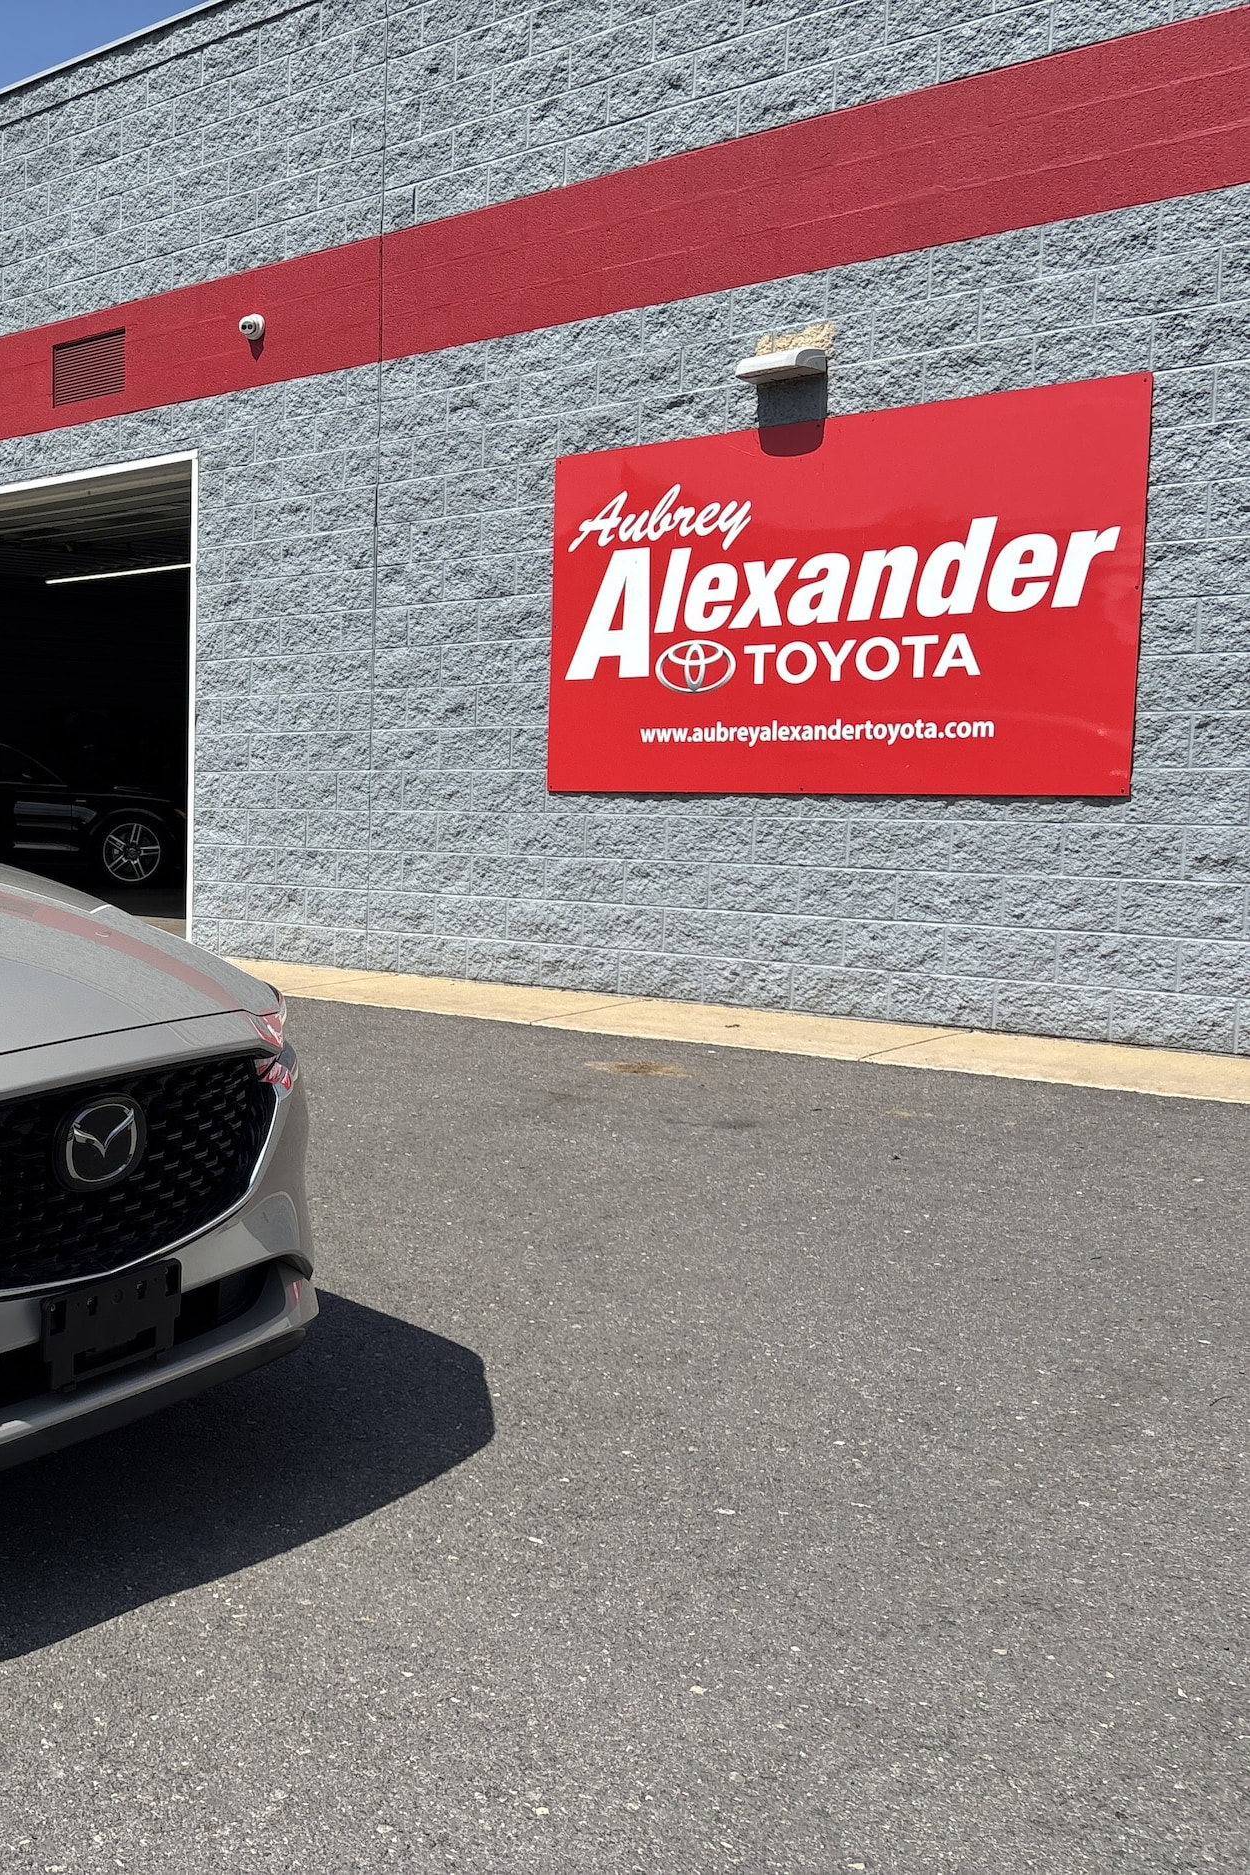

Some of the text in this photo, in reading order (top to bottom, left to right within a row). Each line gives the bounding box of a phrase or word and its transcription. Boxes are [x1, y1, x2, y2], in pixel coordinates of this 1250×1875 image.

[568, 483, 752, 553] Aubrey
[564, 516, 1121, 681] Alexander
[743, 633, 981, 685] TOYOTA
[640, 718, 995, 747] www.aubreyalexandertoyota.com
